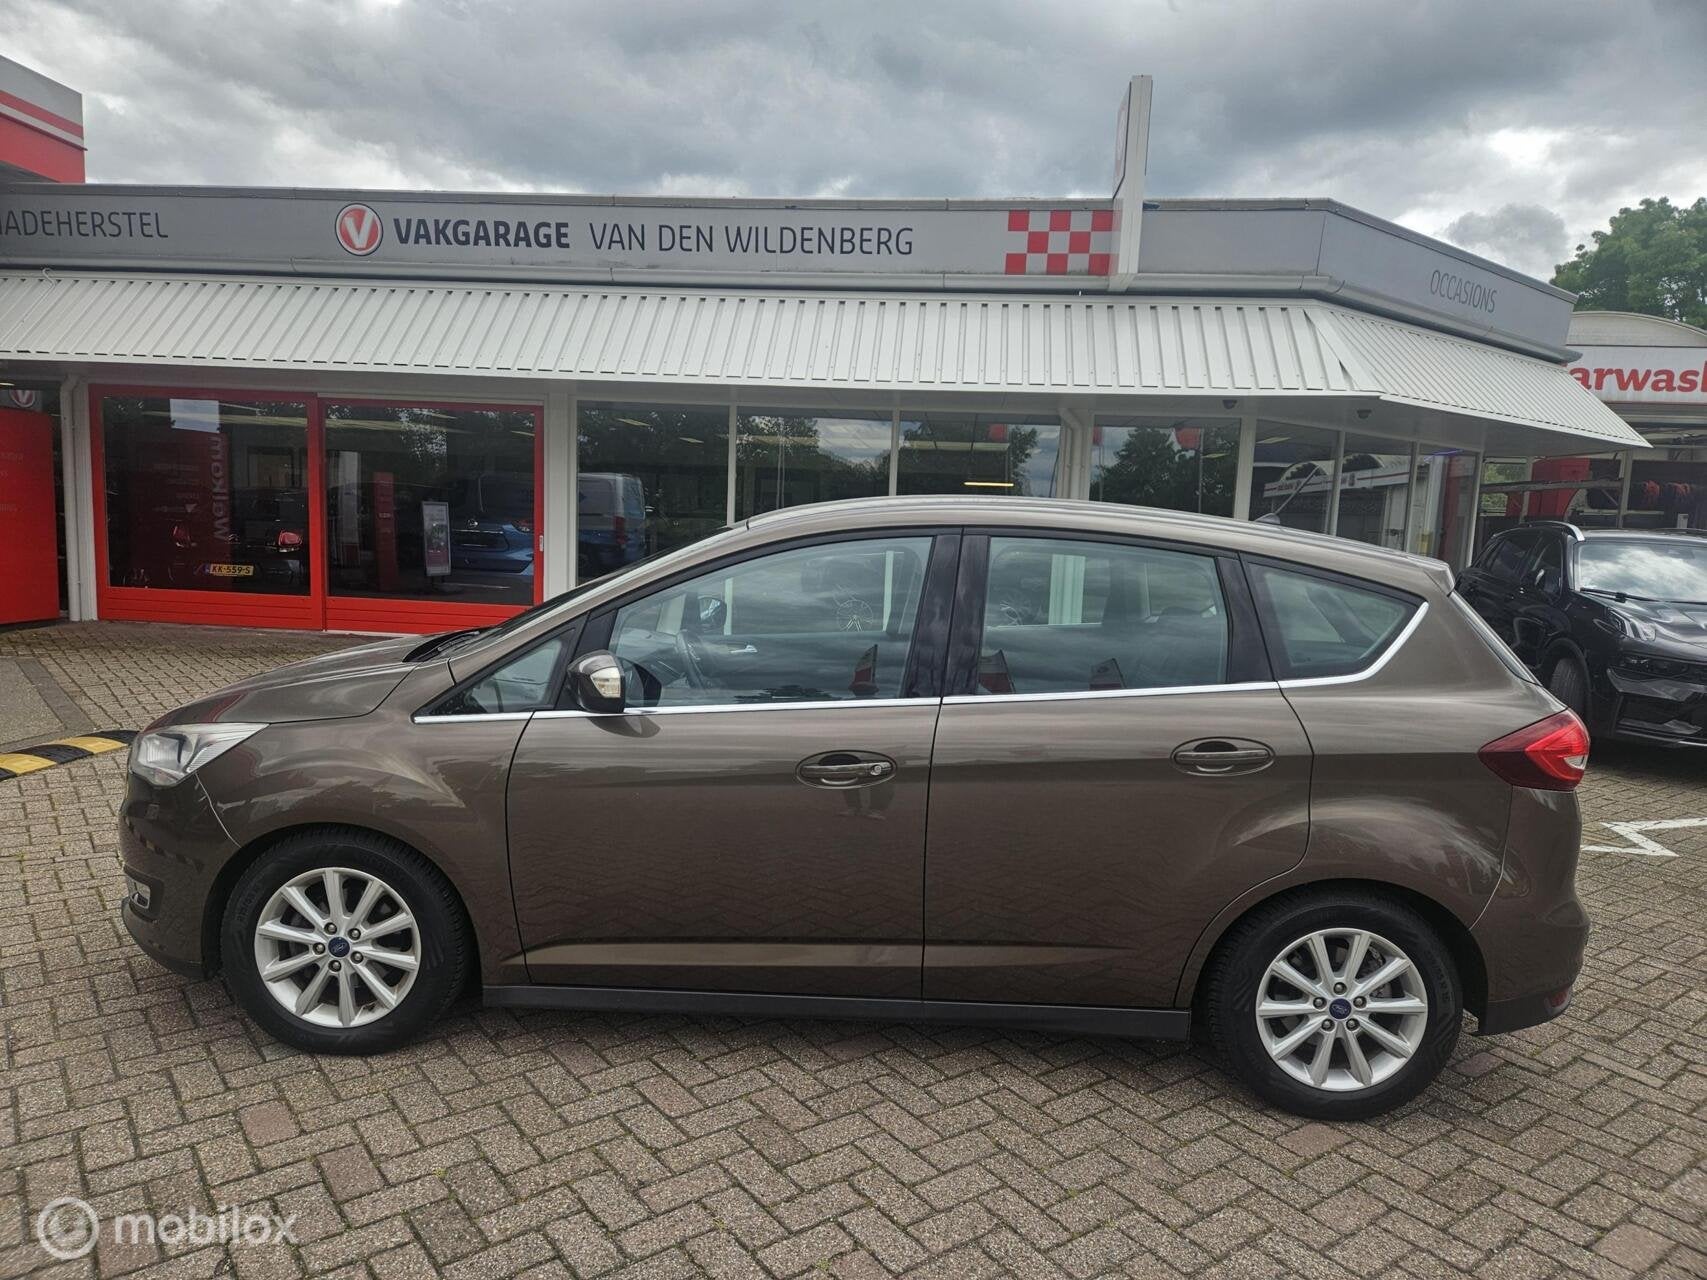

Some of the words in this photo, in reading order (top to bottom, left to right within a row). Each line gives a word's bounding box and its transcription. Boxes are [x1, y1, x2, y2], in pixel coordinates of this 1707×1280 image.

[0, 210, 169, 238] ADEHERSTEL
[393, 217, 571, 249] VAKGARAGE
[589, 222, 646, 251] VAN
[658, 224, 713, 252] DEN
[724, 225, 914, 255] WILDENBERG
[1430, 269, 1498, 313] OCCASIONS
[1561, 361, 1707, 393] arwas
